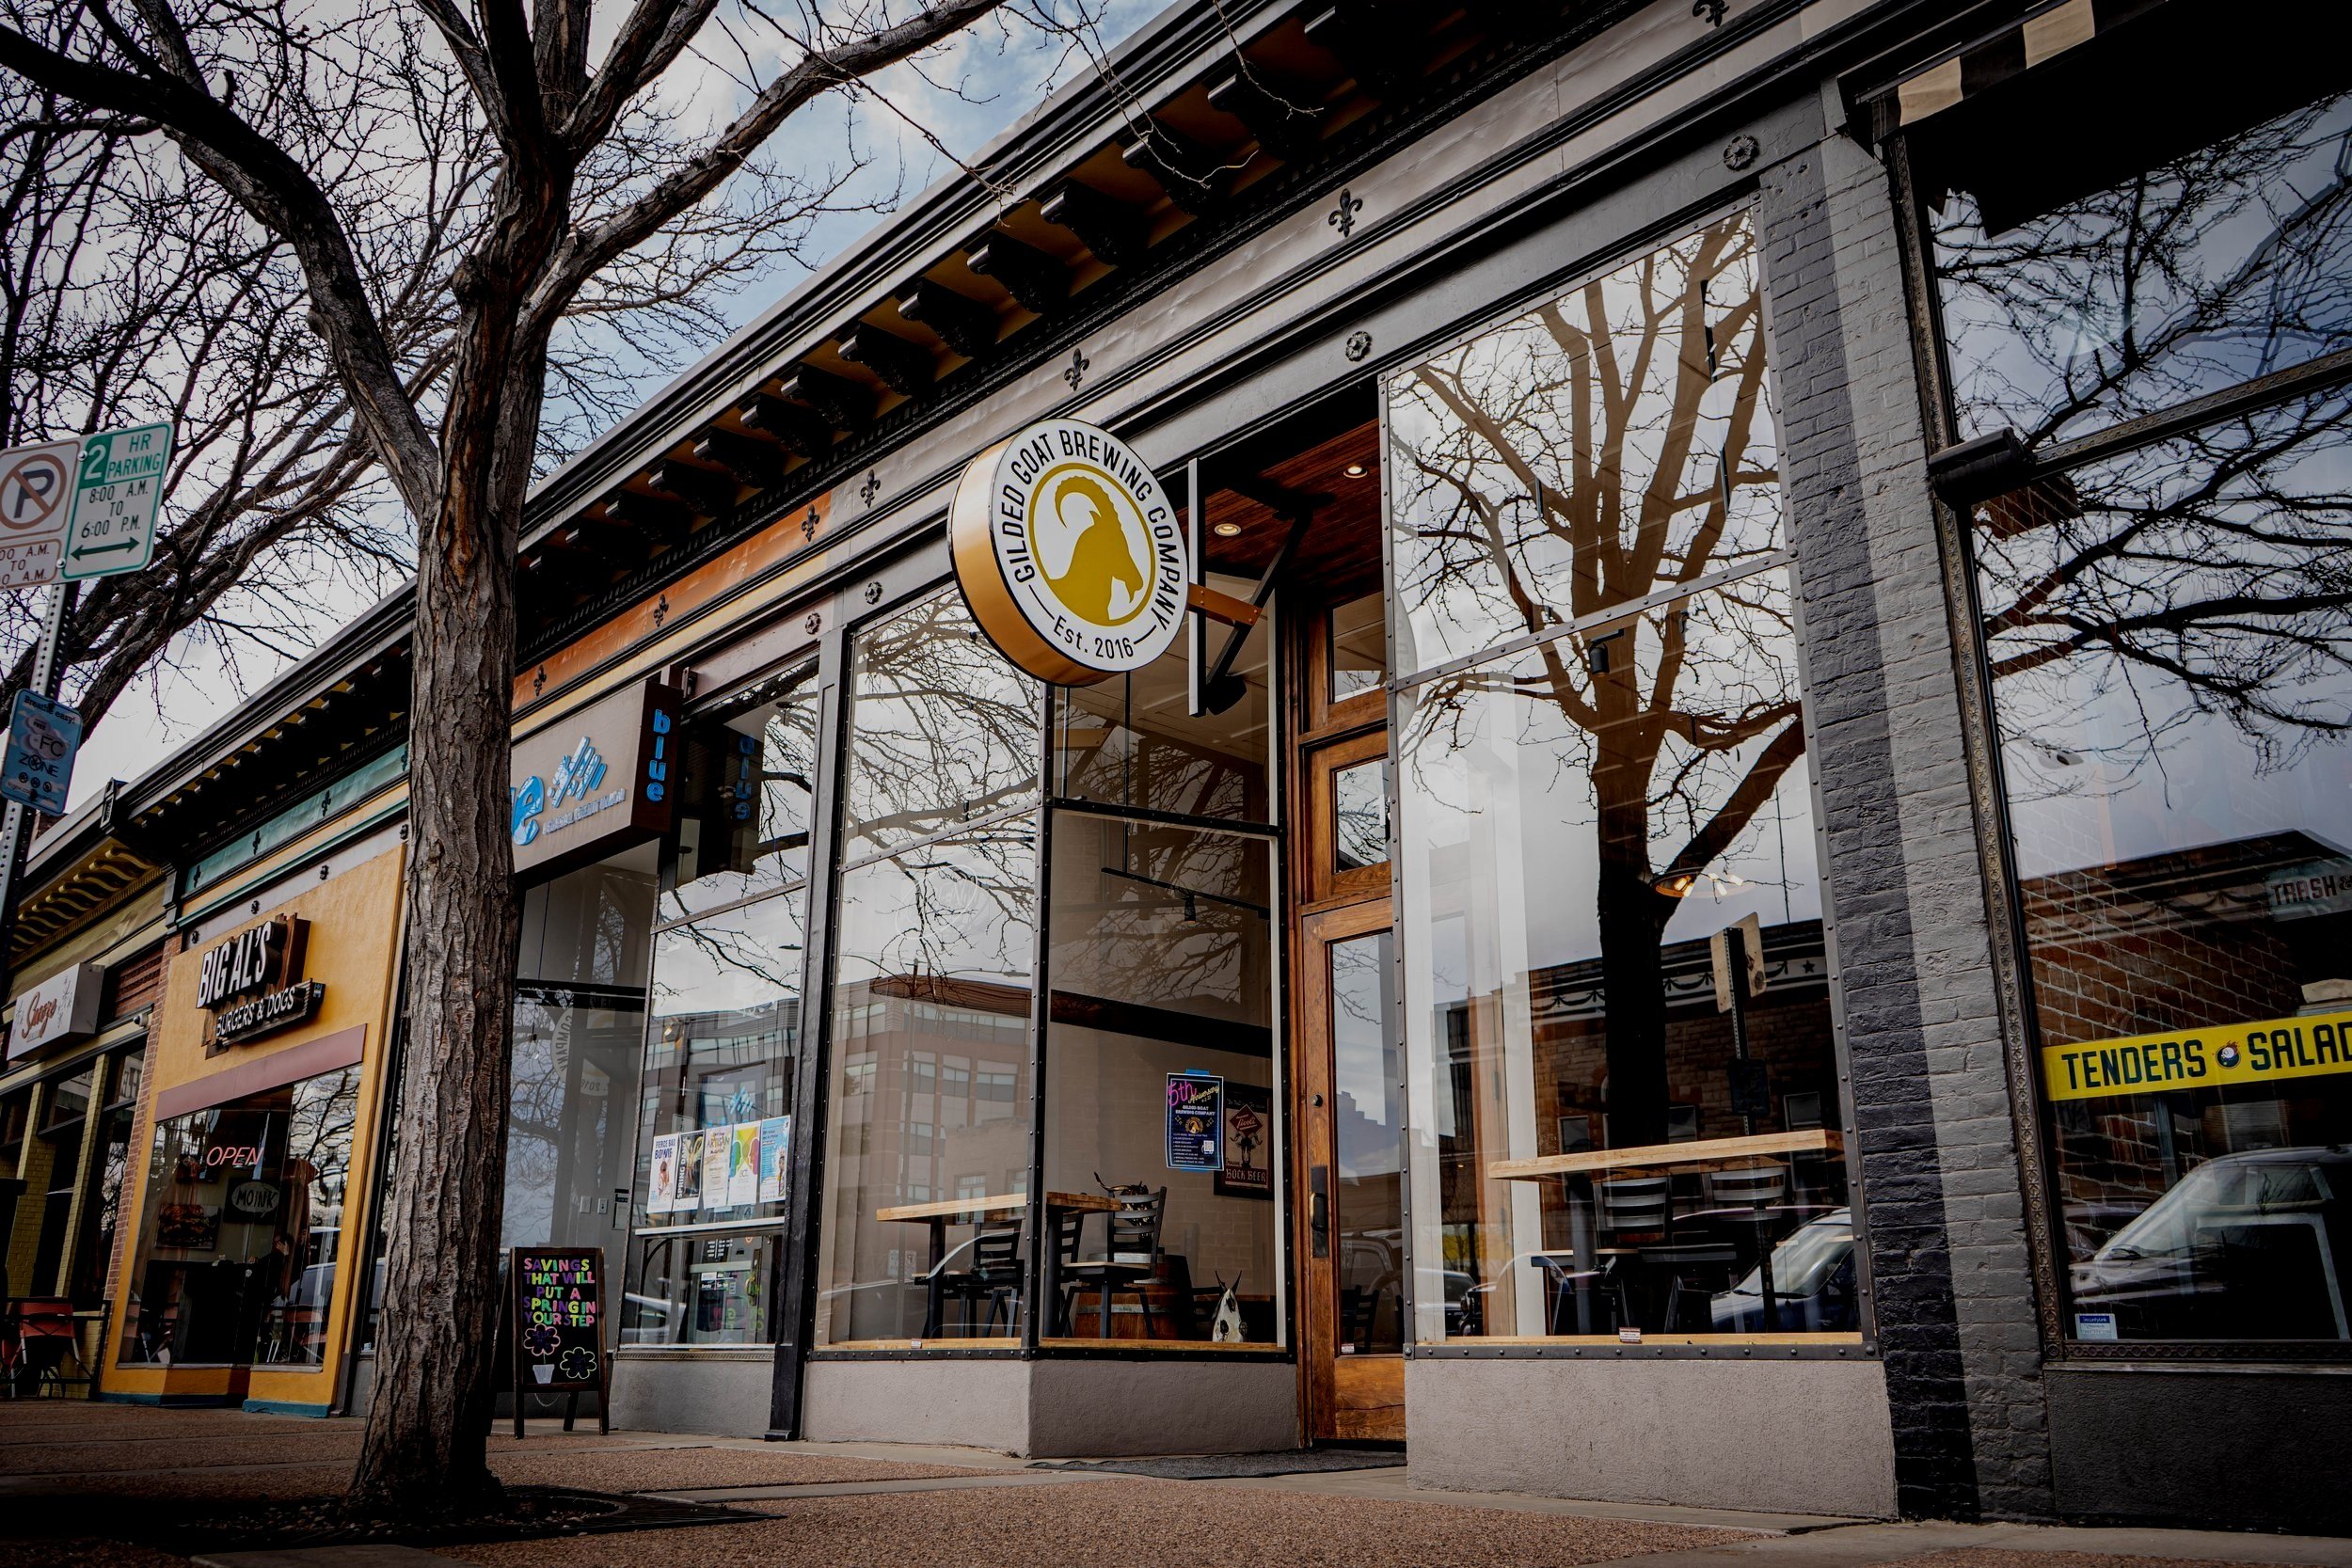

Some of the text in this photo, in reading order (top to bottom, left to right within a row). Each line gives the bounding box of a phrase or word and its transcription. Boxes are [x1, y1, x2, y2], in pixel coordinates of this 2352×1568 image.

[84, 433, 152, 481] 2 HR
[106, 452, 161, 480] PARKING
[88, 479, 149, 504] 8:00 A.M.
[109, 500, 125, 517] TO
[81, 515, 141, 539] 6:00 P.M.
[1000, 429, 1181, 631] GILDED GOAT BREWING COMPANY
[25, 544, 50, 557] A.M.
[10, 559, 26, 572] TO
[23, 568, 47, 581] A.M.
[1053, 614, 1135, 659] Est. 2016
[39, 735, 64, 757] FC
[646, 708, 672, 803] blue
[196, 921, 273, 1009] BIG AL'S
[216, 986, 296, 1037] BURGERS & DOGS
[2061, 1038, 2207, 1090] TENDERS
[1168, 1080, 1198, 1106] 5th
[206, 1146, 264, 1166] OPEN
[676, 1165, 686, 1200] SPRING
[1225, 1167, 1266, 1182] BOCK BEER
[235, 1188, 279, 1209] MOINK
[523, 1257, 591, 1273] SAVINGS
[523, 1271, 596, 1286] THAT WILL
[535, 1285, 581, 1300] PUT A
[522, 1296, 597, 1314] SPRING IN
[522, 1310, 596, 1328] YOUR STEP
